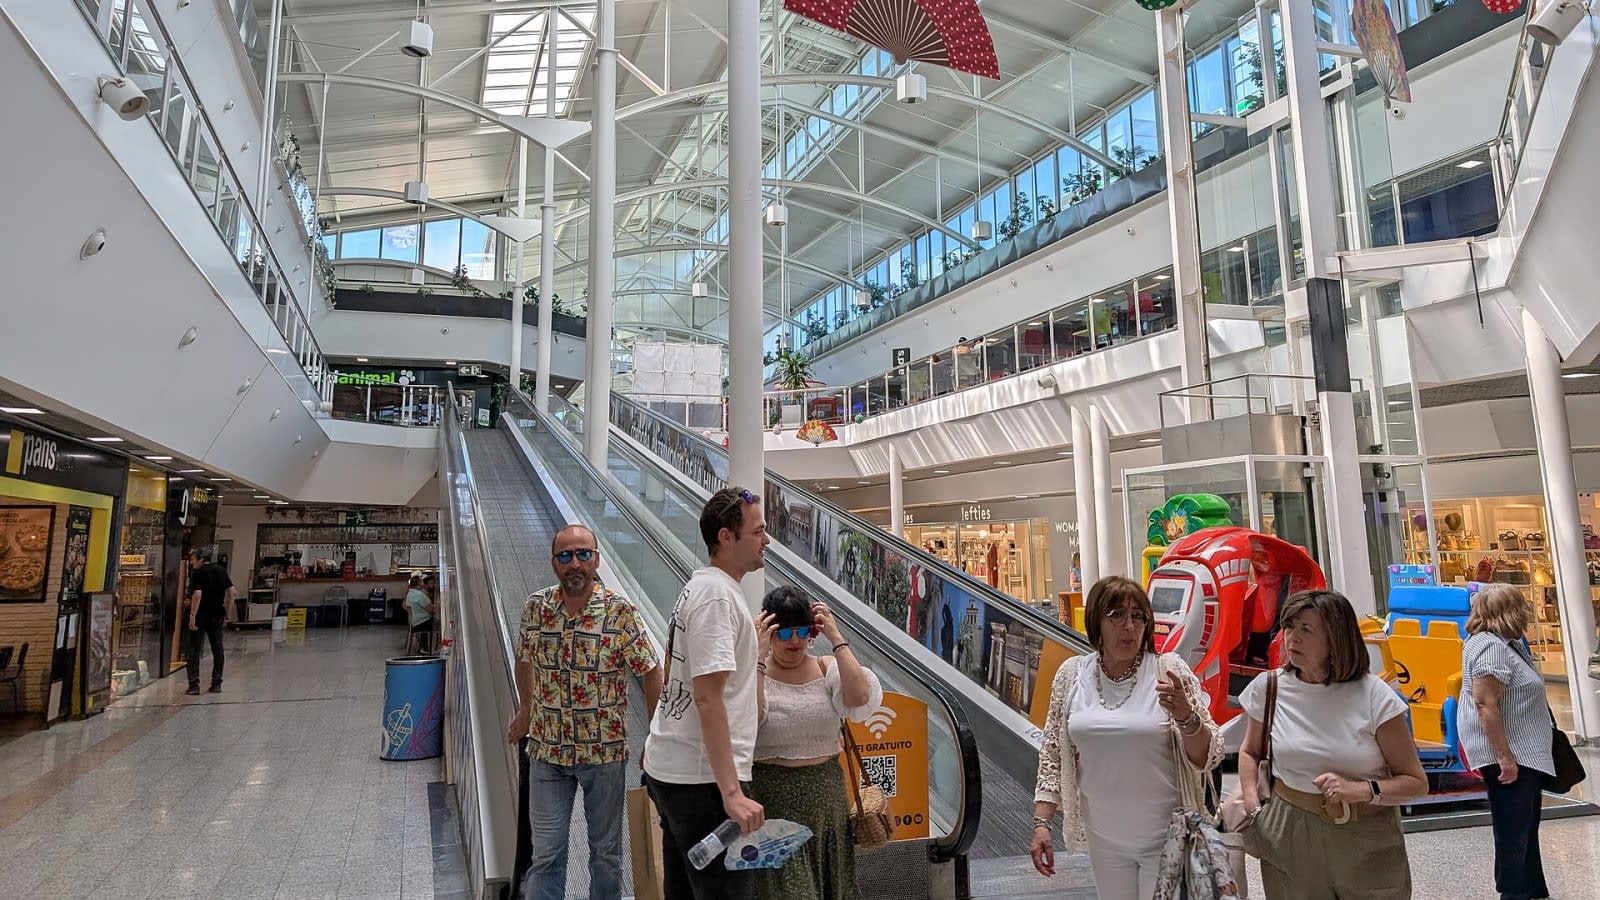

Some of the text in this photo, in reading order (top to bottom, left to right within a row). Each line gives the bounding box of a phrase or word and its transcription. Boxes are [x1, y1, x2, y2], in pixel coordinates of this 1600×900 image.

[23, 434, 57, 475] pans
[961, 505, 991, 521] lefties
[865, 740, 912, 752] GRATUITO
